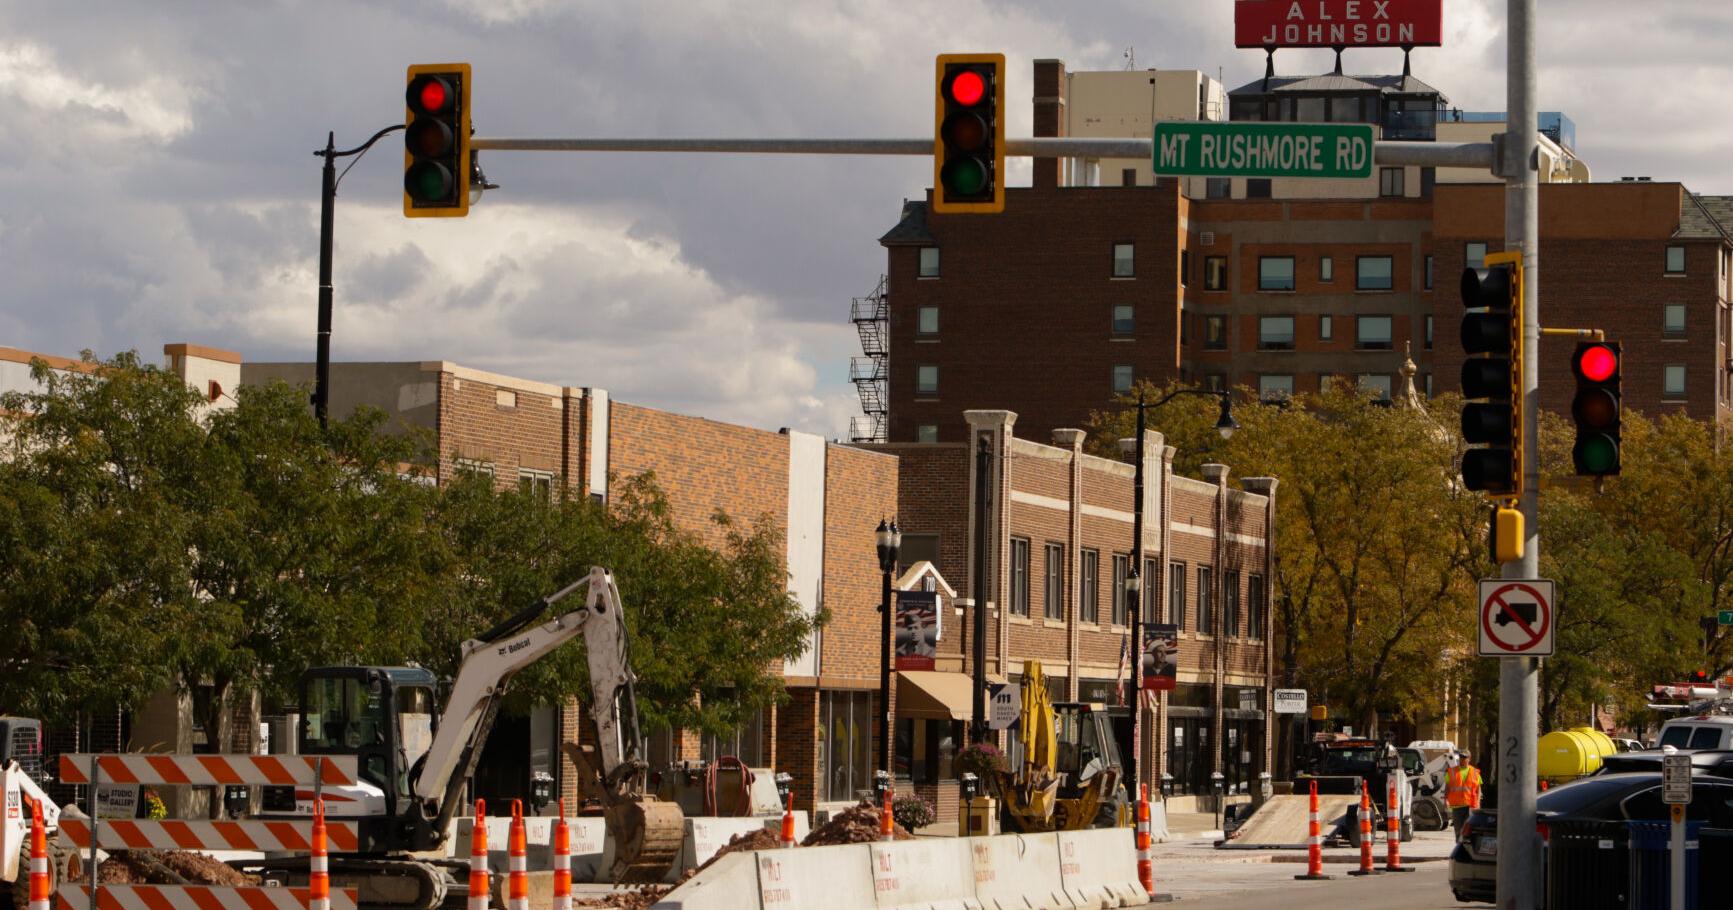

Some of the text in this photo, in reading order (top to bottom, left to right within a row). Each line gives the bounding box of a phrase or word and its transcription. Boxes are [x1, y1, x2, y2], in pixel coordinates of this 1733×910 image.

[1287, 1, 1389, 20] ALEX
[1263, 23, 1414, 43] JOHNSON
[1160, 133, 1367, 171] MT RUSHMORE RD
[509, 637, 531, 653] Bobcat
[111, 789, 133, 798] STUDIO
[110, 798, 135, 807] GALLERY
